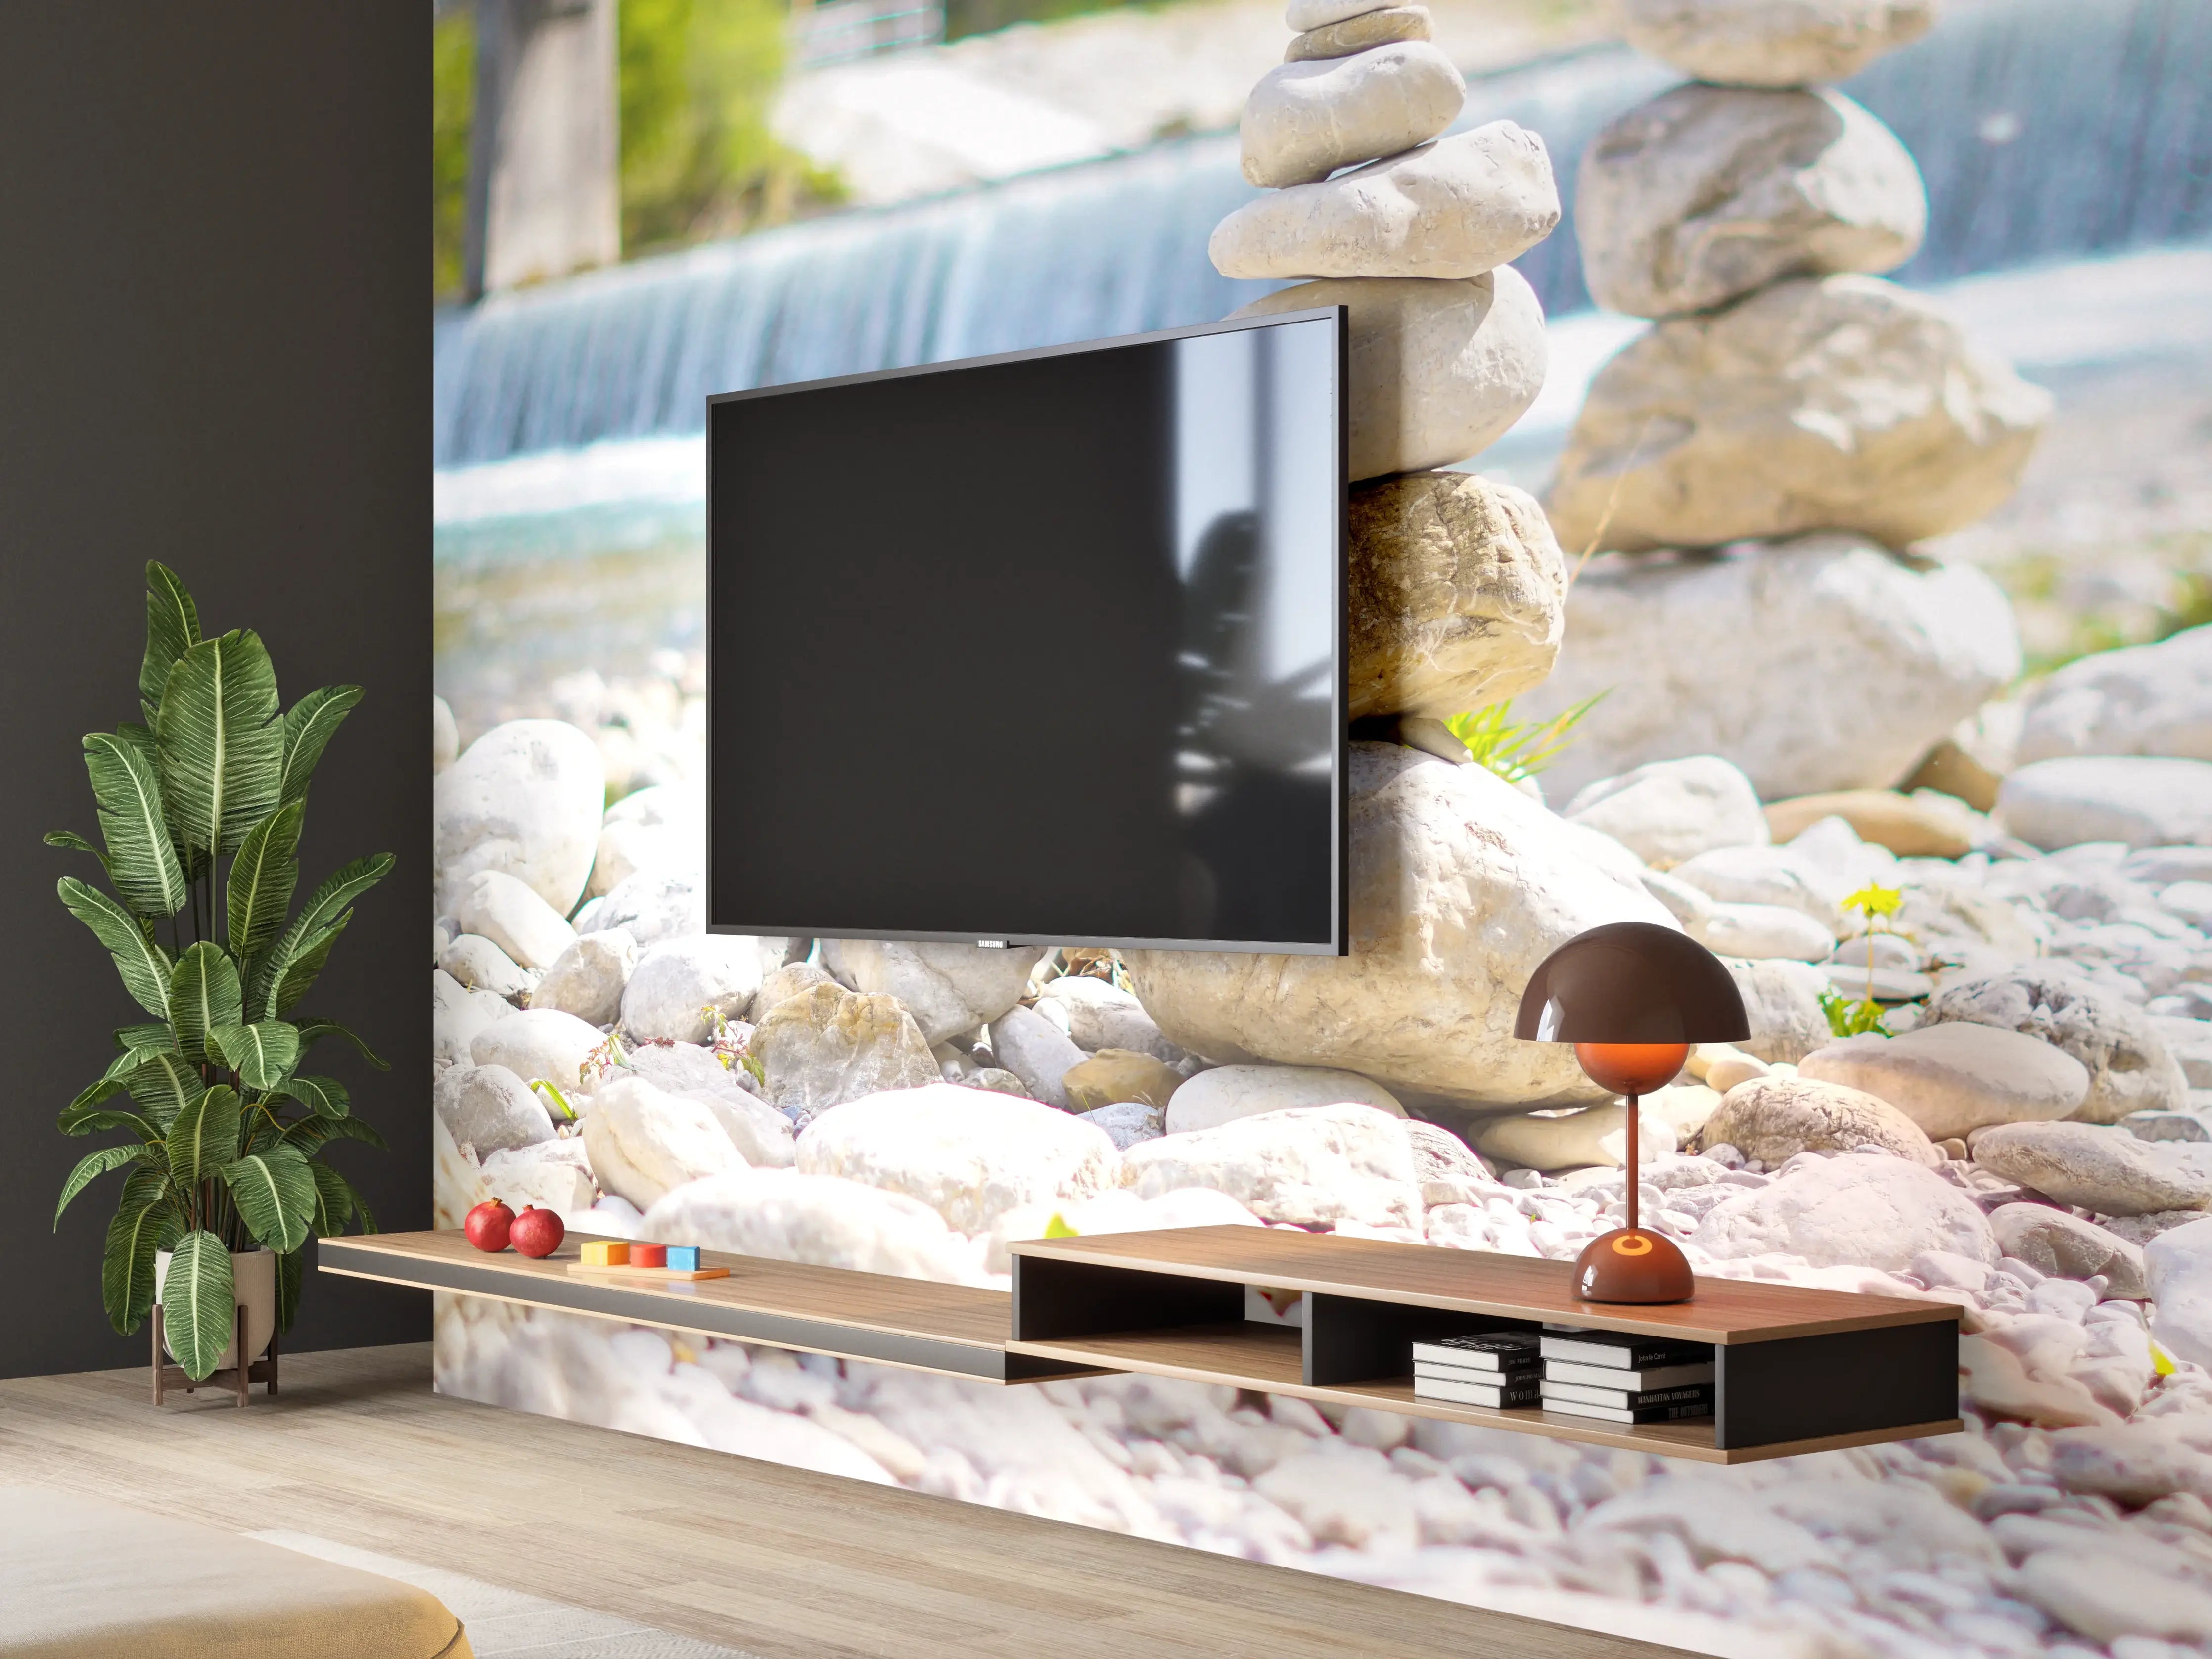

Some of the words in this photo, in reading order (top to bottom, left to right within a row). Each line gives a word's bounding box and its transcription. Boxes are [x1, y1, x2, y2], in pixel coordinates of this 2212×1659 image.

[1638, 1355, 1648, 1363] John
[1638, 1393, 1670, 1405] MANHATTAN
[1671, 1389, 1700, 1400] VOYAGERS
[1668, 1407, 1679, 1419] THE
